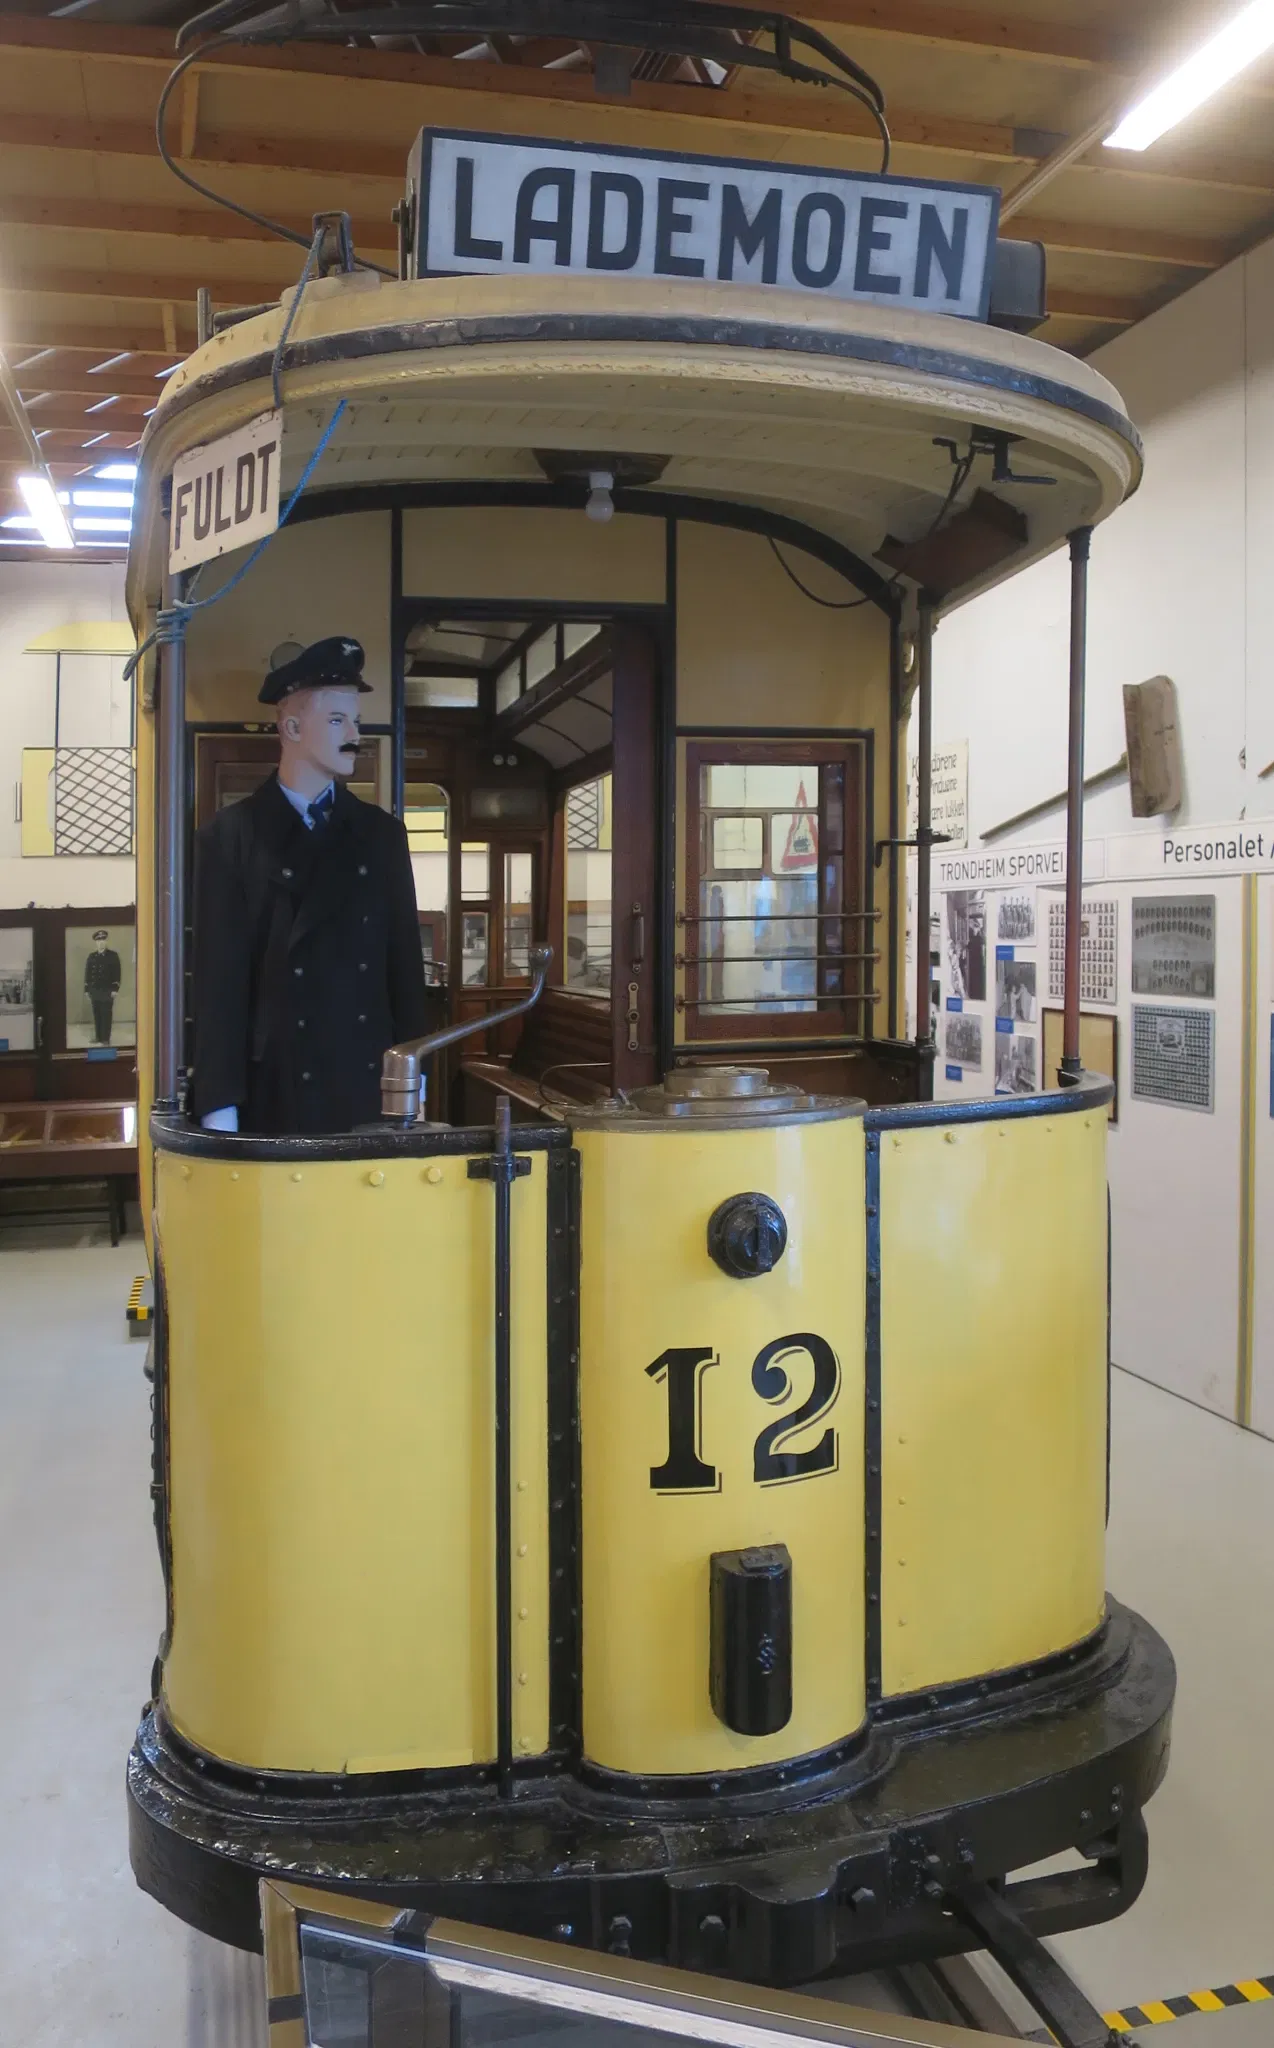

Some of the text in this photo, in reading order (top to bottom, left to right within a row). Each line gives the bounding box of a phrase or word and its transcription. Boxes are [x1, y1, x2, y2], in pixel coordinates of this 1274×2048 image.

[453, 156, 969, 301] LADEMOEN
[174, 440, 277, 551] FULDT
[940, 857, 1005, 881] TRONDHEIM
[1163, 832, 1264, 863] Personalet
[644, 1332, 842, 1496] 12
